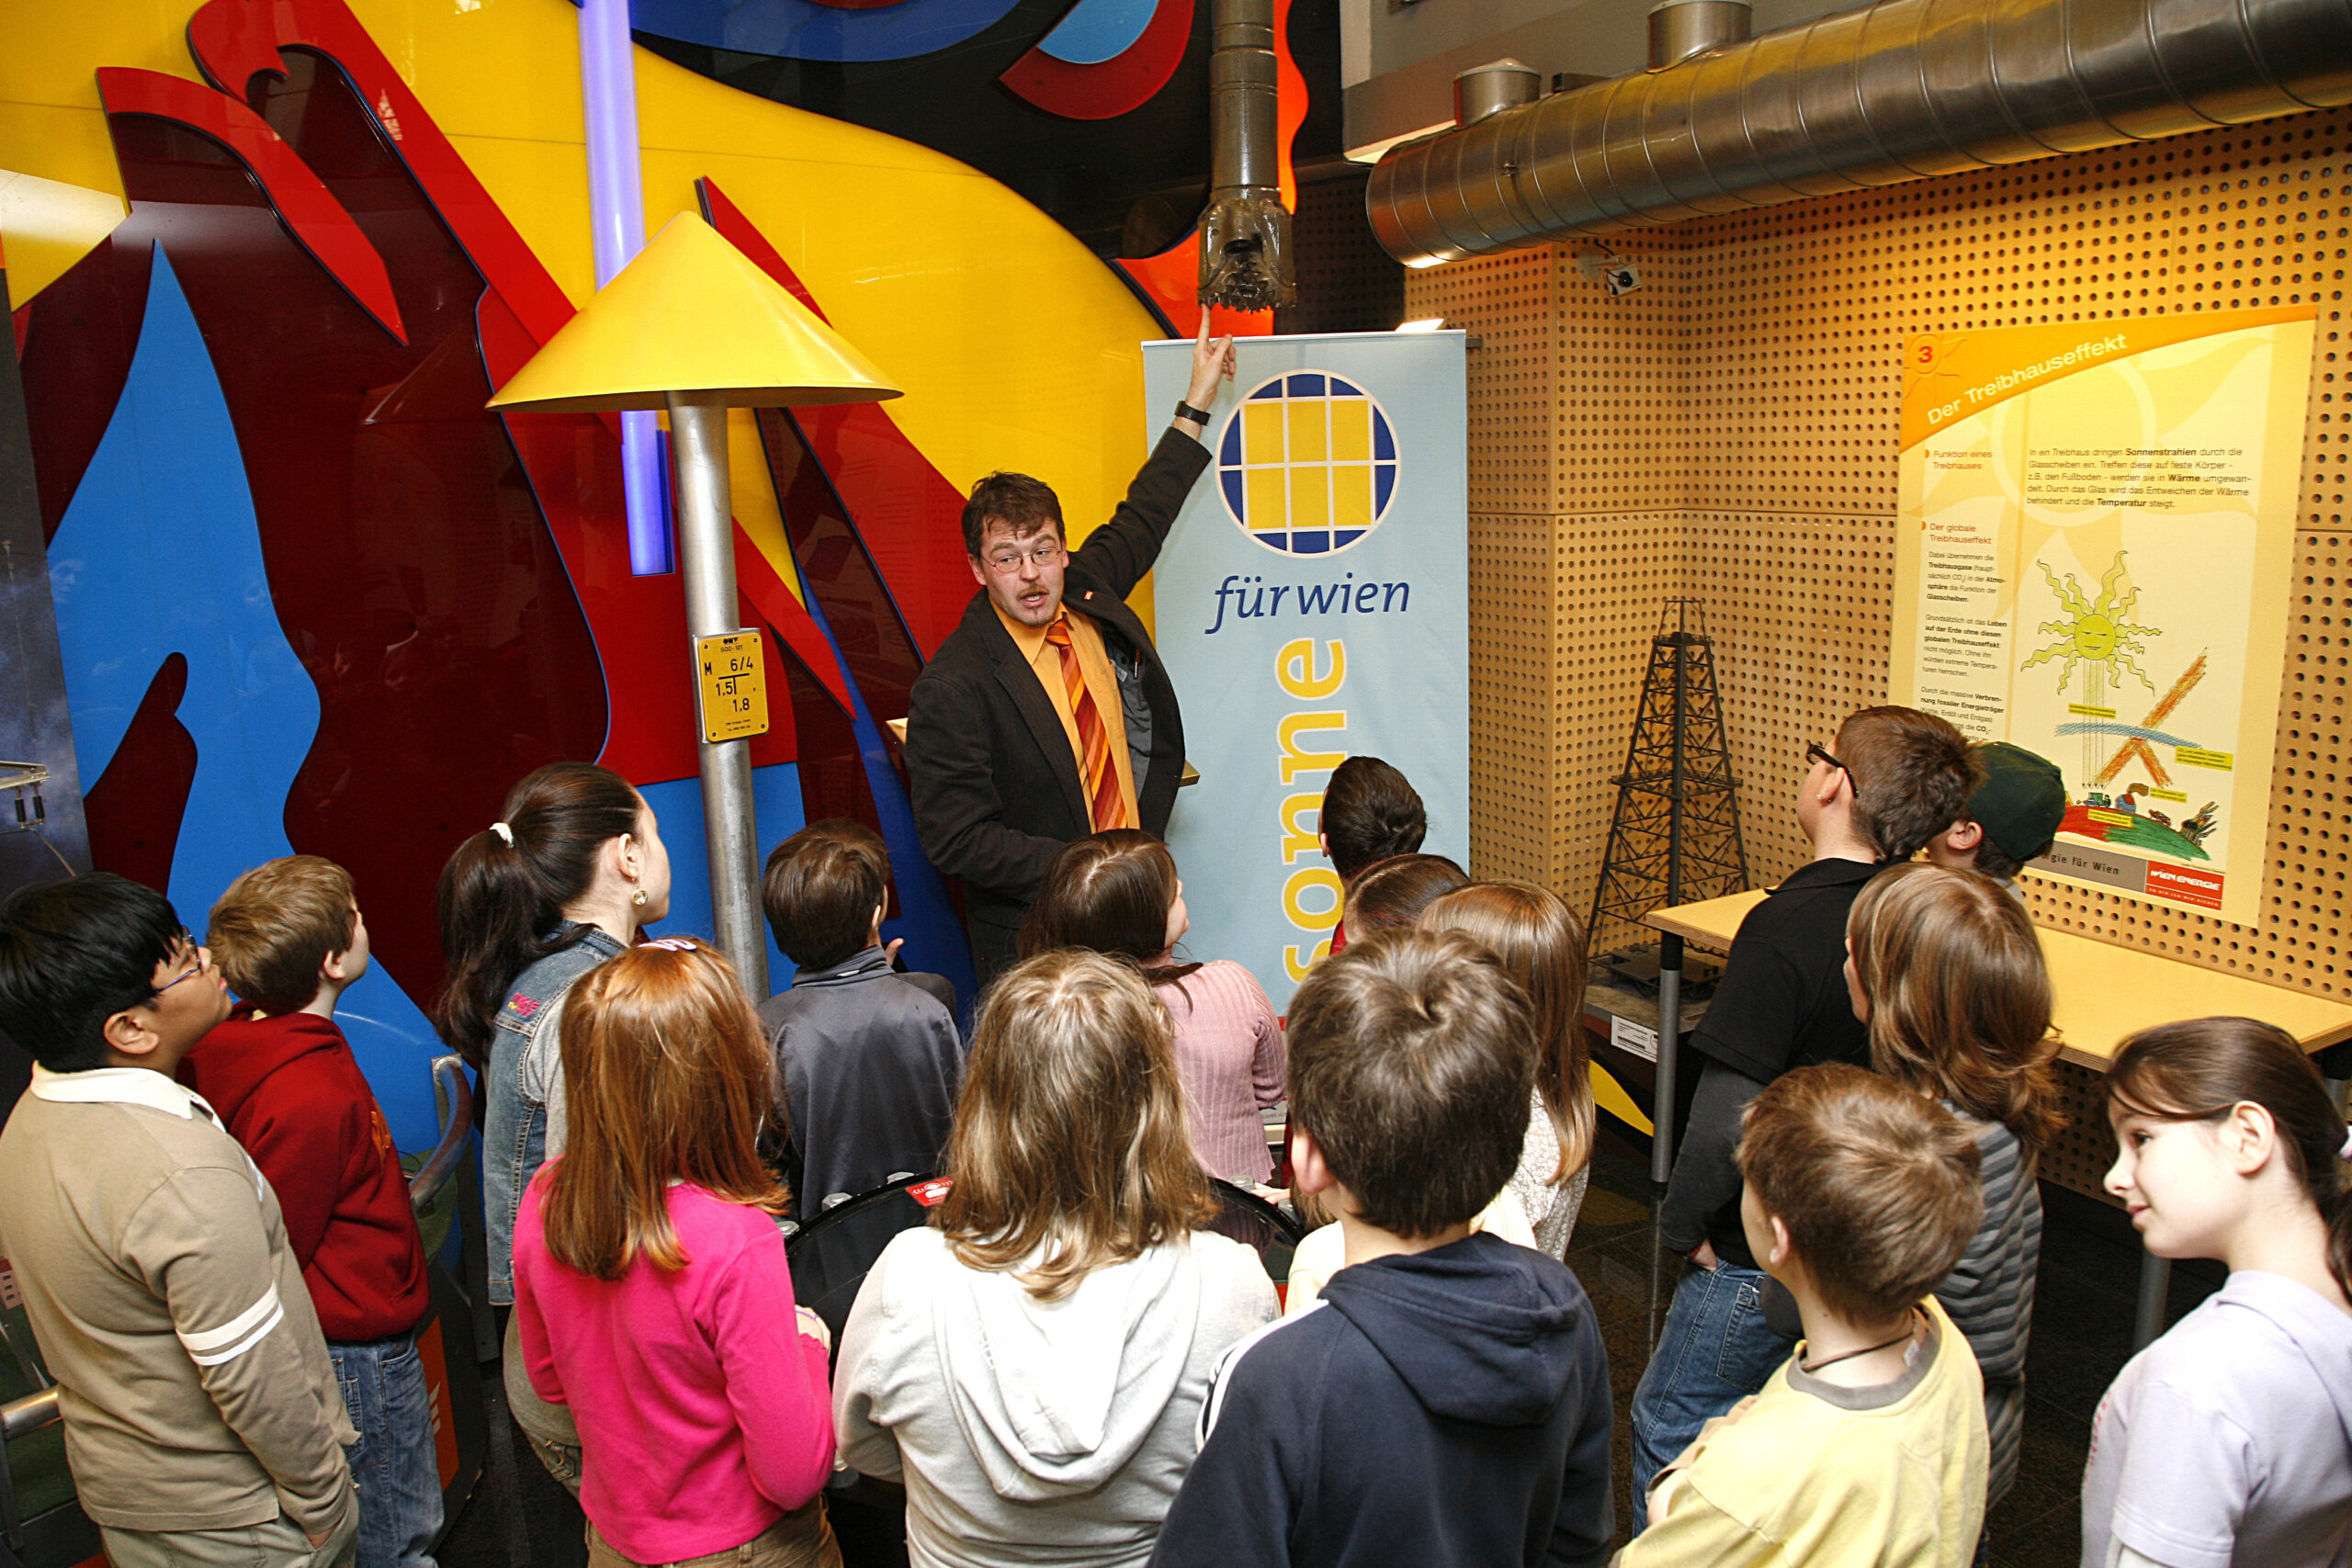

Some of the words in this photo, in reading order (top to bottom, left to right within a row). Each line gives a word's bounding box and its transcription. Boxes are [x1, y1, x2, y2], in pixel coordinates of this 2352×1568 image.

[1917, 345, 1933, 364] 3
[1927, 399, 1962, 425] Der
[1964, 333, 2127, 403] Treibhauseffekt
[1933, 450, 1967, 458] Funktion
[2029, 448, 2037, 457] In
[2052, 448, 2089, 457] Treibhaus
[2092, 449, 2123, 458] dringen
[2125, 448, 2197, 457] Sonnenstrahlen
[2199, 448, 2225, 457] durch
[2228, 448, 2243, 457] die
[1933, 462, 1983, 470] Treibhauses
[2100, 461, 2127, 469] Treffen
[2130, 461, 2152, 469] diese
[2154, 461, 2169, 469] auf
[2171, 461, 2192, 469] feste
[2195, 461, 2225, 471] Körper
[2062, 473, 2101, 481] Fußboden
[2143, 474, 2155, 482] sie
[2157, 474, 2165, 482] in
[2167, 474, 2200, 482] Wärme
[2046, 485, 2069, 493] Durch
[2071, 485, 2086, 493] das
[2109, 486, 2126, 494] wird
[2129, 486, 2143, 494] das
[2146, 487, 2196, 495] Entweichen
[2216, 488, 2249, 496] Wärme
[2082, 498, 2095, 506] die
[2097, 498, 2146, 508] Temperatur
[2149, 501, 2176, 510] steigt.
[1946, 525, 1976, 533] globale
[1929, 535, 1992, 545] Treibhauseffekt
[1928, 562, 1973, 571] Treibhausgase
[1951, 637, 2000, 649] Treibhauseffekt
[704, 661, 713, 676] M
[730, 657, 753, 671] 6/4
[716, 682, 733, 696] 1,5
[732, 698, 750, 713] 1,8
[1962, 702, 2004, 714] Energieträger
[2073, 857, 2088, 868] für
[2093, 862, 2120, 875] Wien
[2177, 875, 2222, 891] ENERGIE
